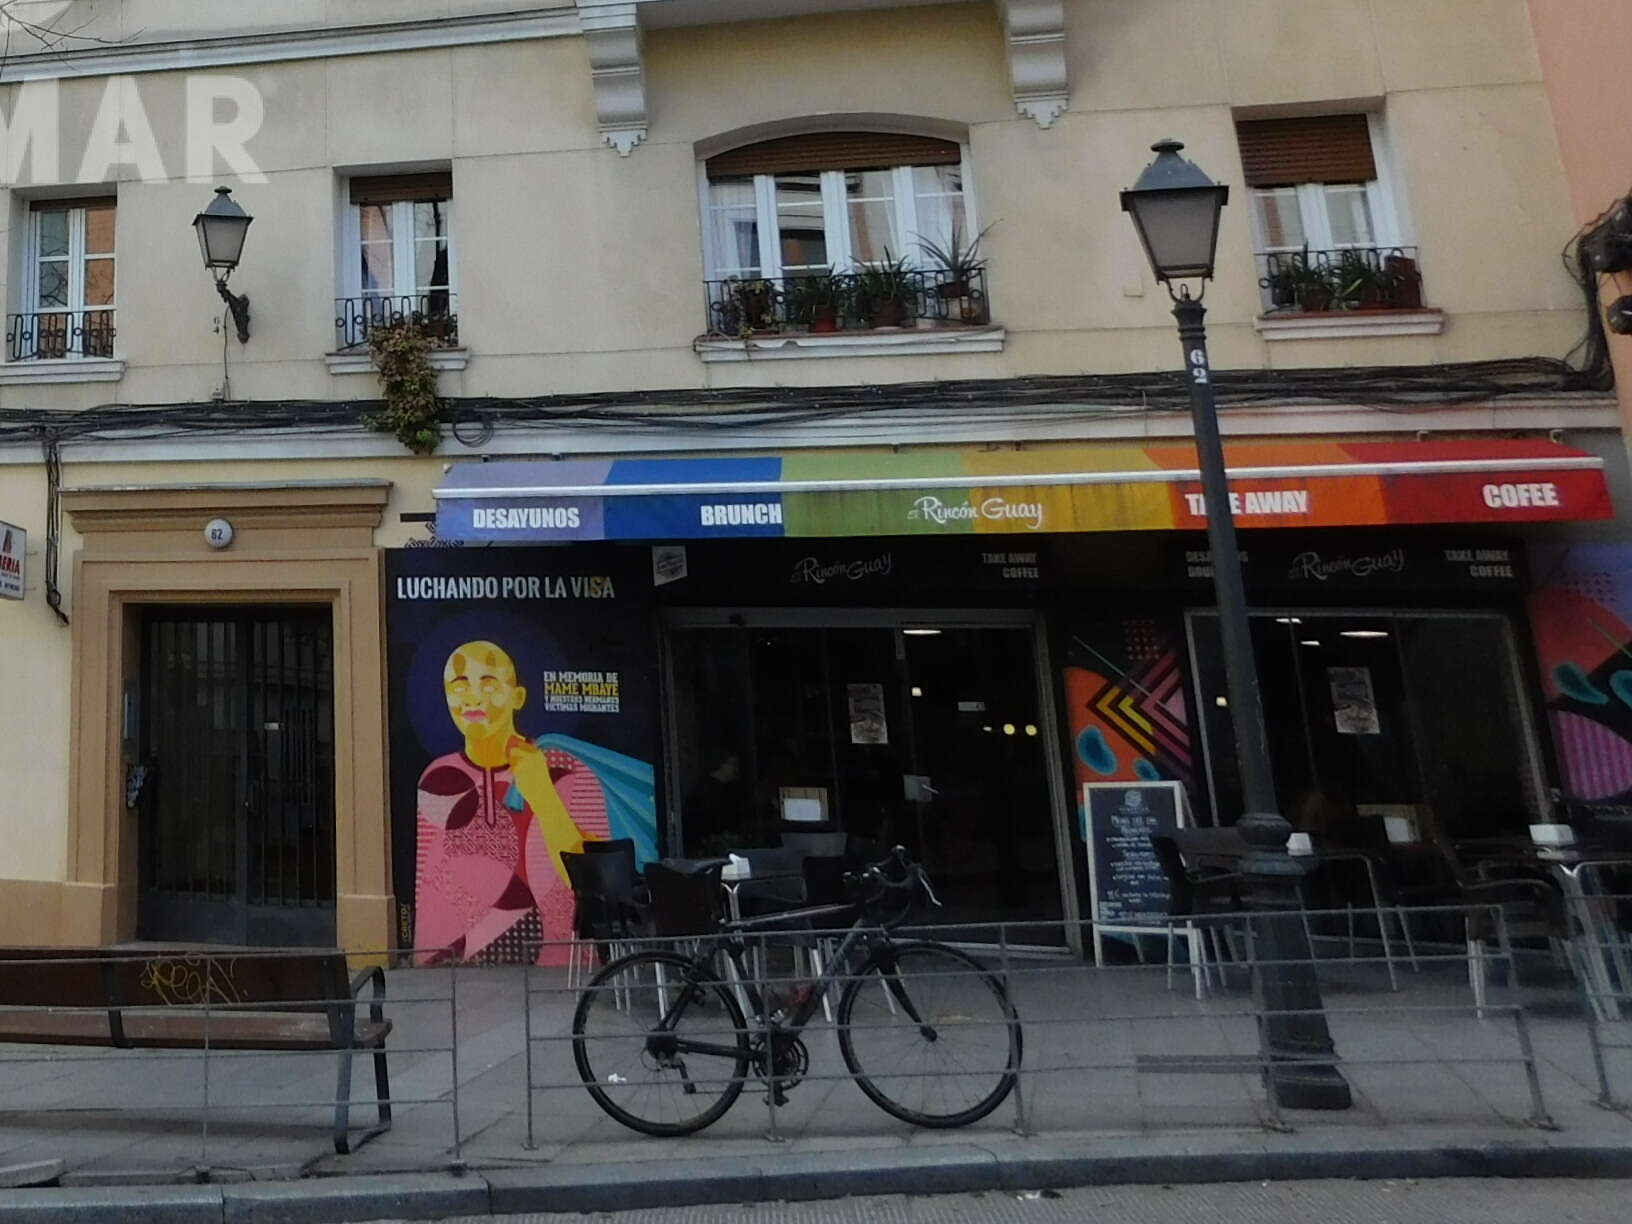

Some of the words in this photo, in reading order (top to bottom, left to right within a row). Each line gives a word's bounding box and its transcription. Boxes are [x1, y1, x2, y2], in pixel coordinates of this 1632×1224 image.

[1245, 490, 1308, 514] AWAY
[1482, 483, 1560, 508] COFEE
[473, 507, 580, 529] DESAYUNOS
[700, 503, 782, 526] BRUNCH
[914, 496, 978, 524] Rincón
[981, 498, 1042, 529] Guay
[397, 577, 498, 599] LUCHANDO
[502, 577, 540, 599] POR
[545, 577, 567, 599] LA
[544, 671, 556, 682] EN
[559, 671, 604, 683] MEMORIA
[544, 682, 579, 695] MAME
